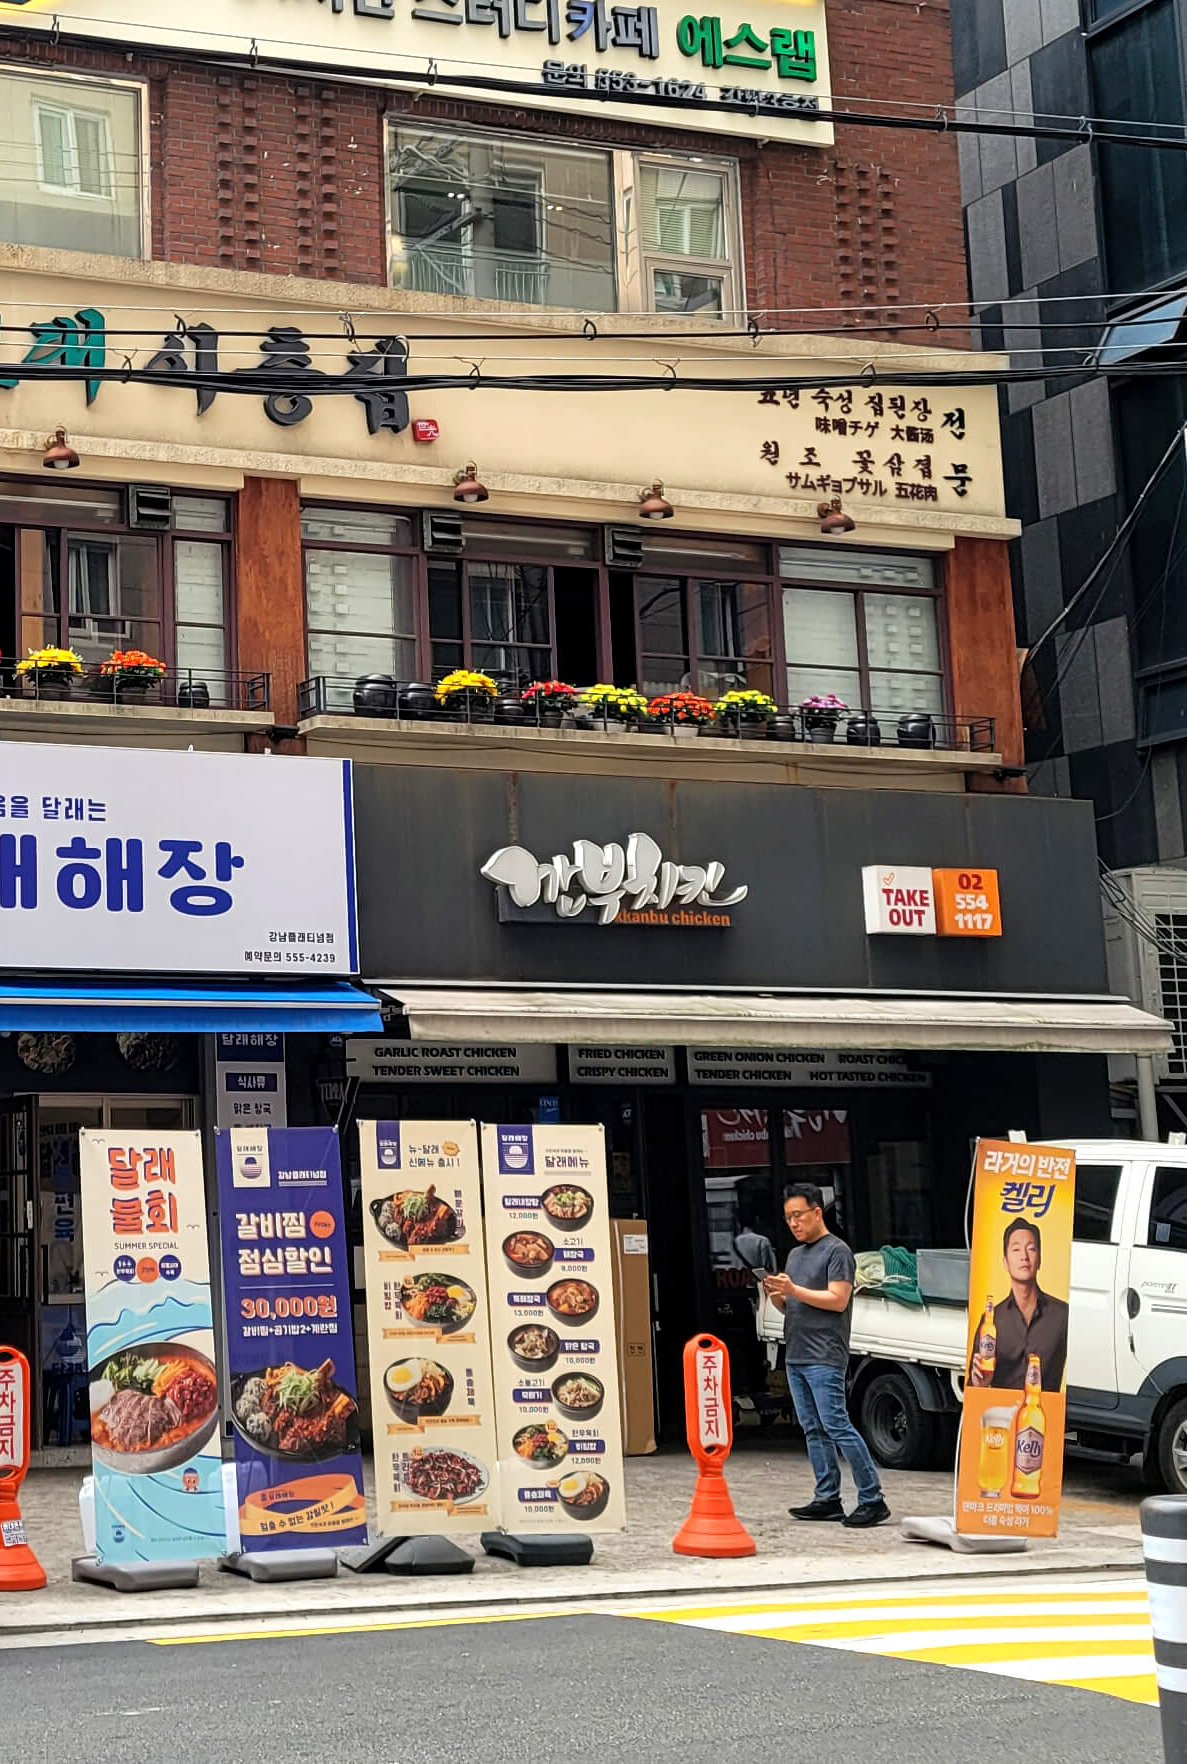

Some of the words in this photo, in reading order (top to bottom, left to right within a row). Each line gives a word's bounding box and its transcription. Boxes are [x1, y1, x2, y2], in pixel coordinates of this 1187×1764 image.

[677, 14, 817, 82] 에스랩
[542, 59, 588, 88] 문의
[810, 387, 854, 415] 숙성
[864, 391, 932, 422] 집된장
[760, 440, 822, 468] 원조
[895, 481, 939, 503] 五花肉
[42, 795, 106, 822] 달래는
[958, 873, 983, 891] 02
[882, 888, 930, 907] TAKE
[955, 893, 989, 910] 554
[671, 911, 731, 927] chicken
[889, 909, 926, 927] OUT
[954, 912, 994, 930] 1117
[268, 931, 334, 944] 강남플래티넘점
[244, 950, 282, 962] 예약문의
[285, 952, 336, 963] 555-4239
[221, 1033, 278, 1047] 달래해장
[374, 1047, 421, 1058] GARLIC
[422, 1047, 463, 1058] ROAST
[464, 1047, 517, 1059] CHICKEN
[578, 1048, 612, 1060] FRIED
[614, 1048, 666, 1060] CHICKEN
[694, 1051, 733, 1063] GREEN
[735, 1051, 774, 1063] ONION
[775, 1052, 825, 1064] CHICKEN
[839, 1053, 875, 1065] ROAST
[372, 1065, 421, 1076] TENDER
[422, 1065, 465, 1076] SWEET
[468, 1066, 520, 1077] CHICKEN
[577, 1066, 616, 1078] CRISPY
[617, 1066, 669, 1078] CHICKEN
[695, 1068, 740, 1080] TENDER
[742, 1068, 792, 1081] CHICKEN
[809, 1070, 835, 1081] HOT
[836, 1070, 876, 1082] TASTED
[877, 1071, 927, 1084] CHICKEN
[107, 1147, 176, 1191] 달래
[983, 1151, 1036, 1177] 라거의
[1037, 1155, 1071, 1180] 반전
[1000, 1181, 1056, 1218] 켈리
[110, 1189, 179, 1236] 물회
[235, 1211, 307, 1240] 갈비찜
[114, 1242, 147, 1250] SUMMER
[148, 1242, 179, 1250] SPECIAL
[238, 1246, 334, 1277] 점심할인
[240, 1294, 338, 1321] 30,000원
[701, 1355, 721, 1440] 주차금지
[1017, 1439, 1041, 1458] Kelly
